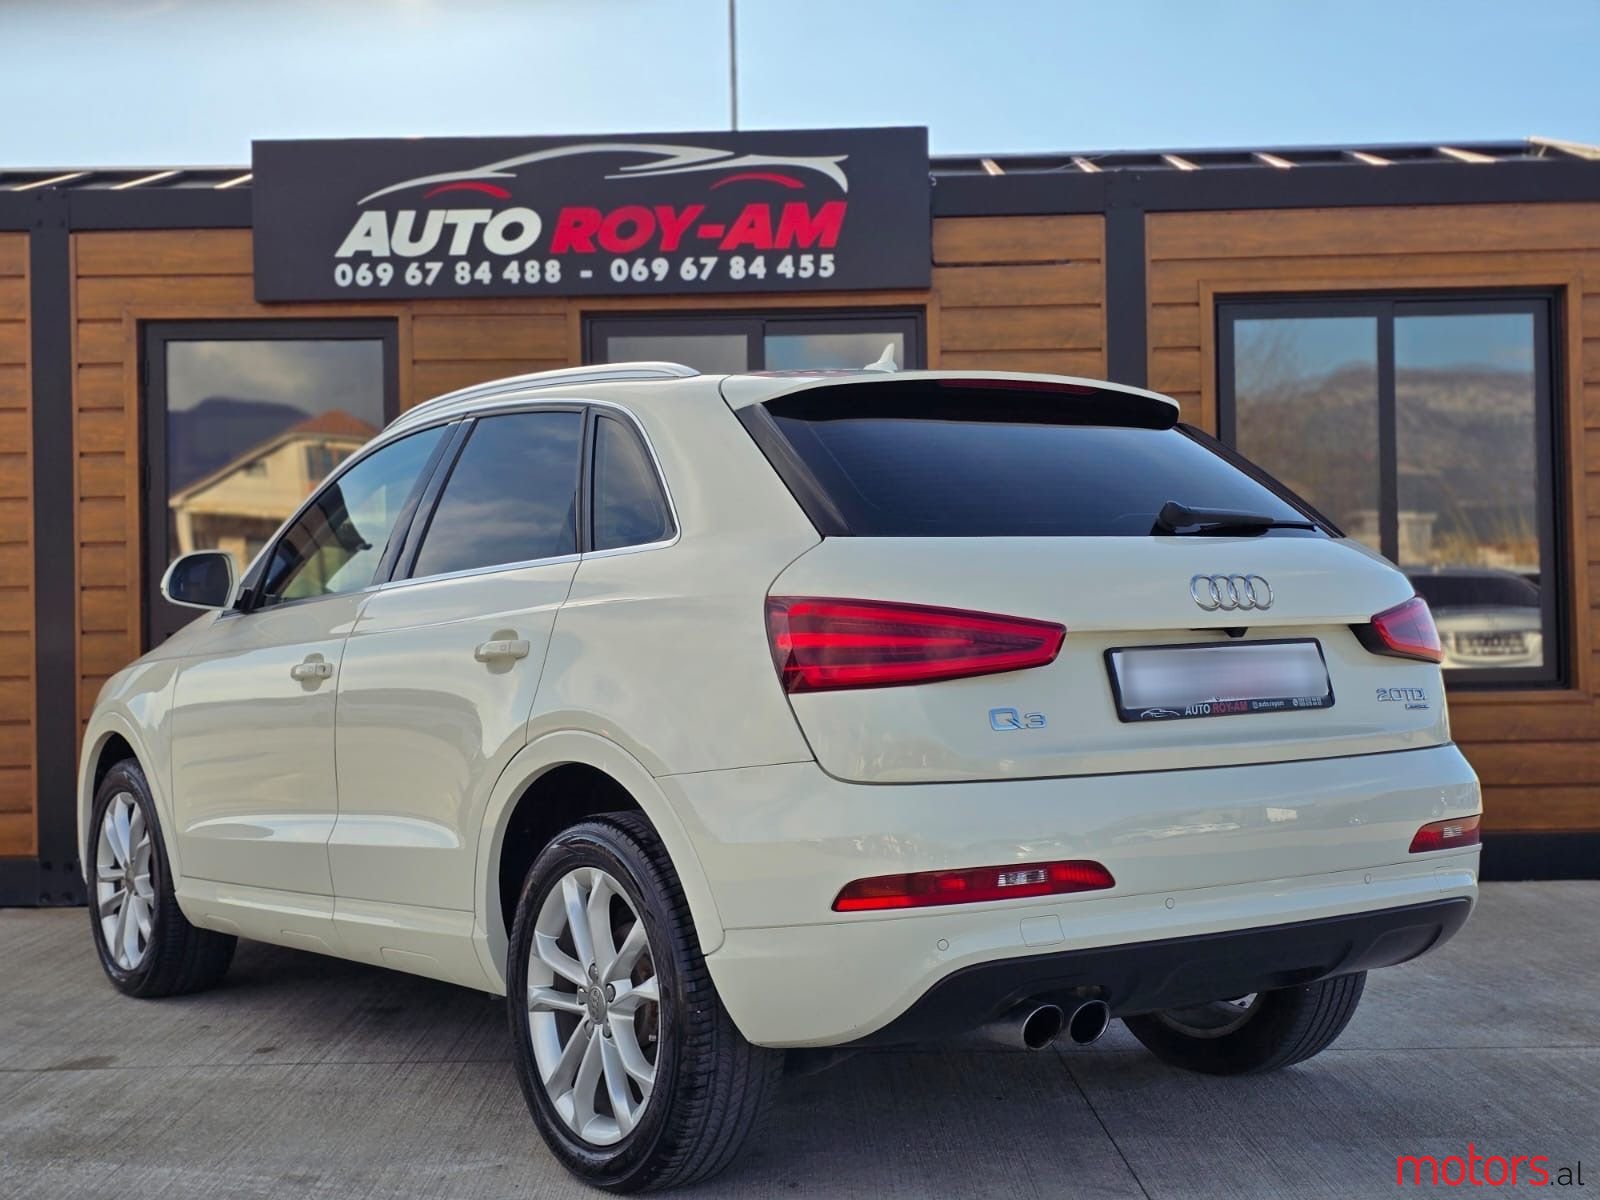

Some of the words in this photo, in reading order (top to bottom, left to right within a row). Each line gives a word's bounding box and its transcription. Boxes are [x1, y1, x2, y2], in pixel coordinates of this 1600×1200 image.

[334, 207, 542, 257] AUTO
[550, 201, 847, 254] ROY-AM
[334, 263, 394, 287] 069
[404, 261, 443, 286] 67
[454, 260, 492, 285] 84
[502, 260, 562, 284] 488
[610, 258, 669, 283] 069
[679, 256, 718, 281] 67
[729, 255, 767, 280] 84
[776, 253, 836, 279] 455
[989, 707, 1048, 731] Q3
[1184, 703, 1211, 716] AUTO
